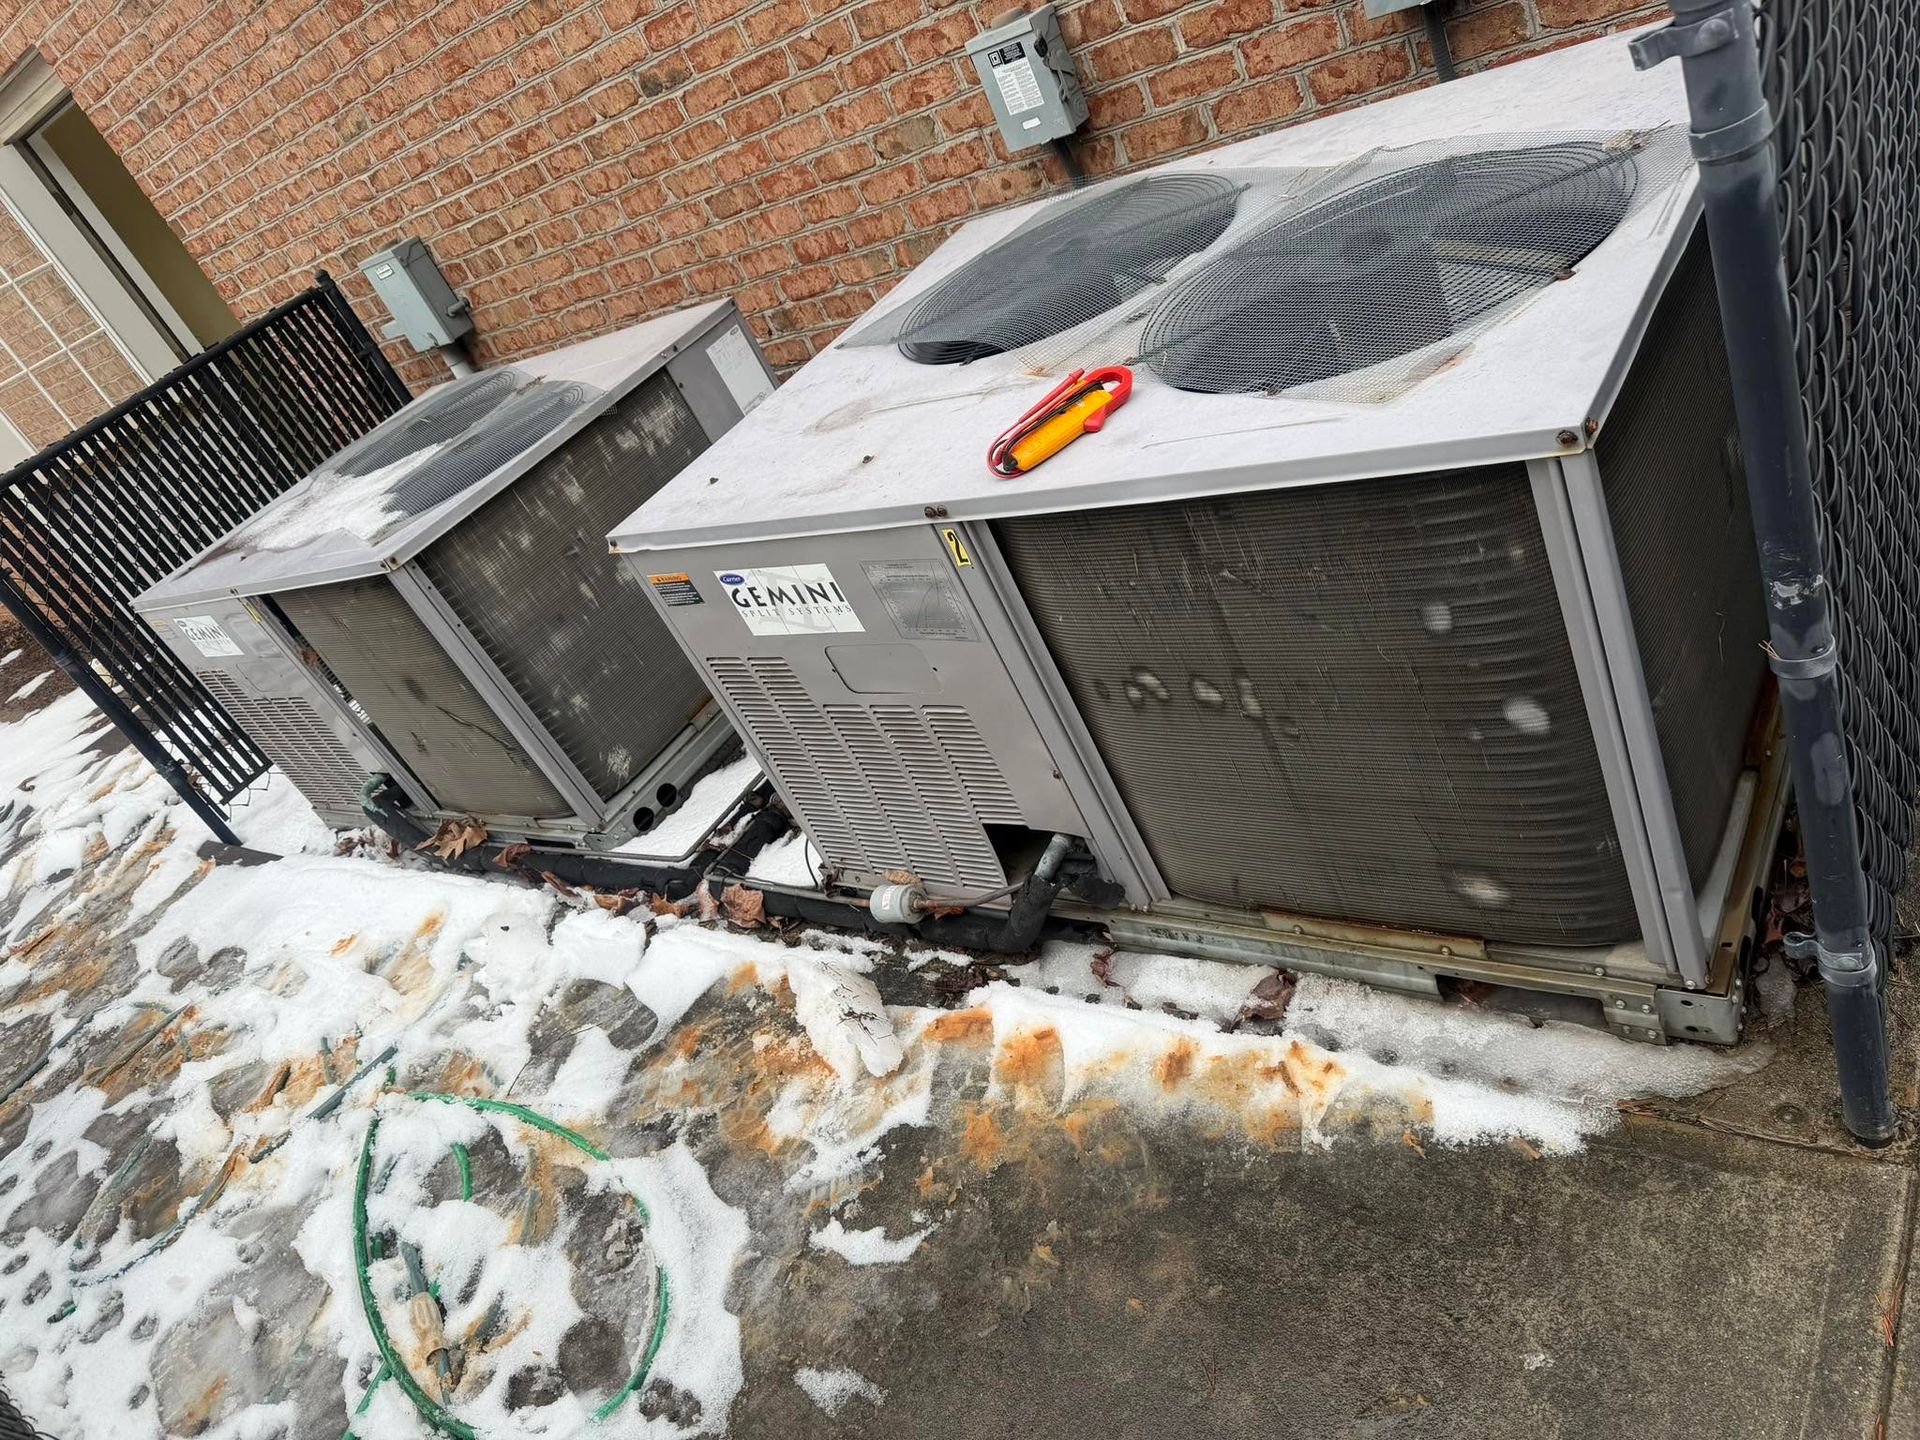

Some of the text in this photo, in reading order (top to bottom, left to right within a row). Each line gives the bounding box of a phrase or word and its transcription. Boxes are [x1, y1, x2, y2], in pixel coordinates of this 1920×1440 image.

[946, 531, 969, 563] 2
[731, 582, 845, 608] GEMINI
[742, 604, 852, 618] SPLIT SYSTEMS
[185, 625, 229, 641] GEMINI
